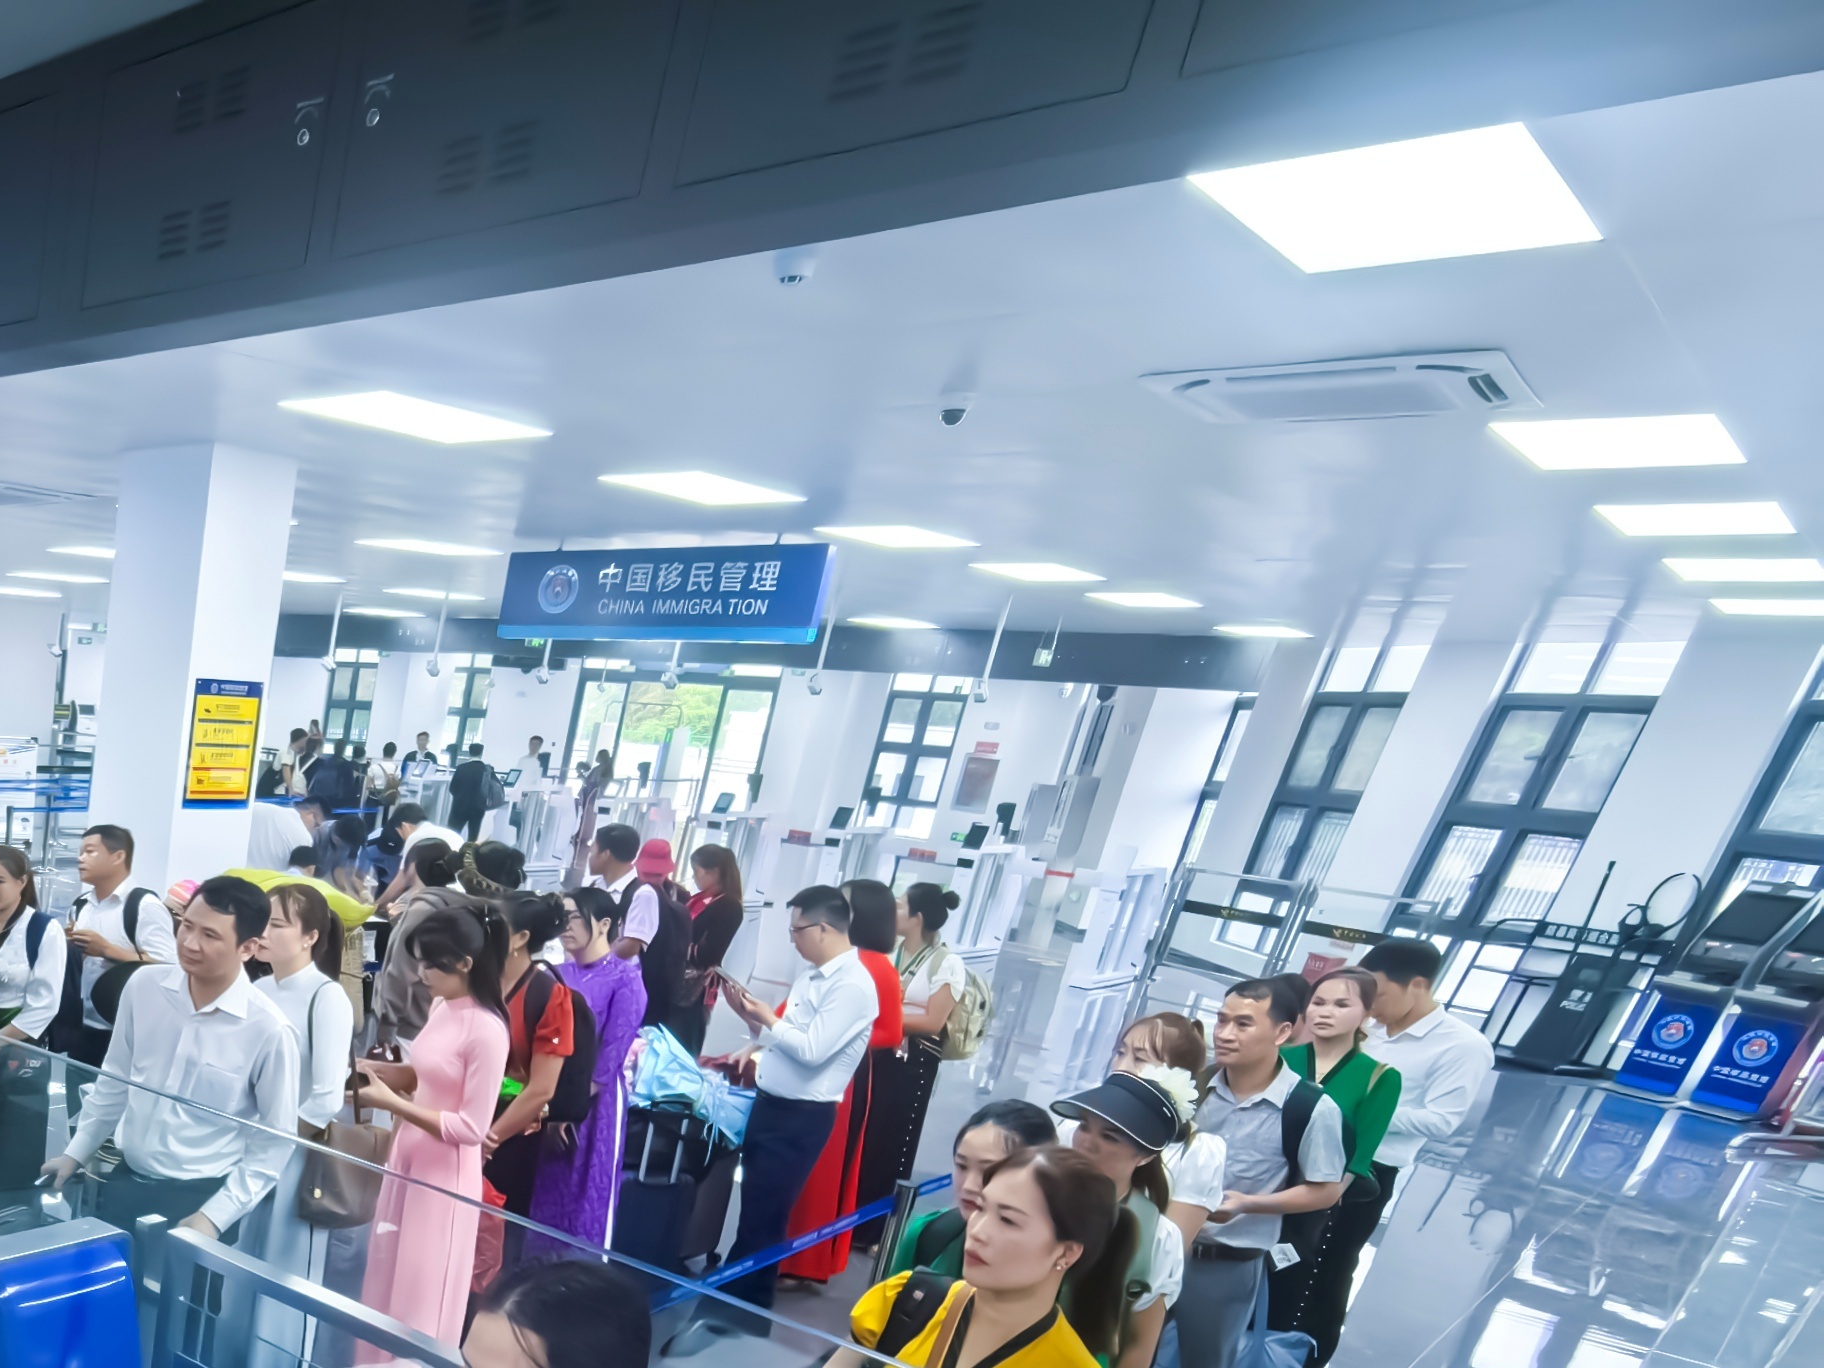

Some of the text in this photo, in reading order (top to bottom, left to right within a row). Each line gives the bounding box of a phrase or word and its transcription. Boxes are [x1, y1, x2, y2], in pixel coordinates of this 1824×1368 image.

[598, 560, 781, 594] 中国移民管理
[597, 598, 645, 616] CHINA
